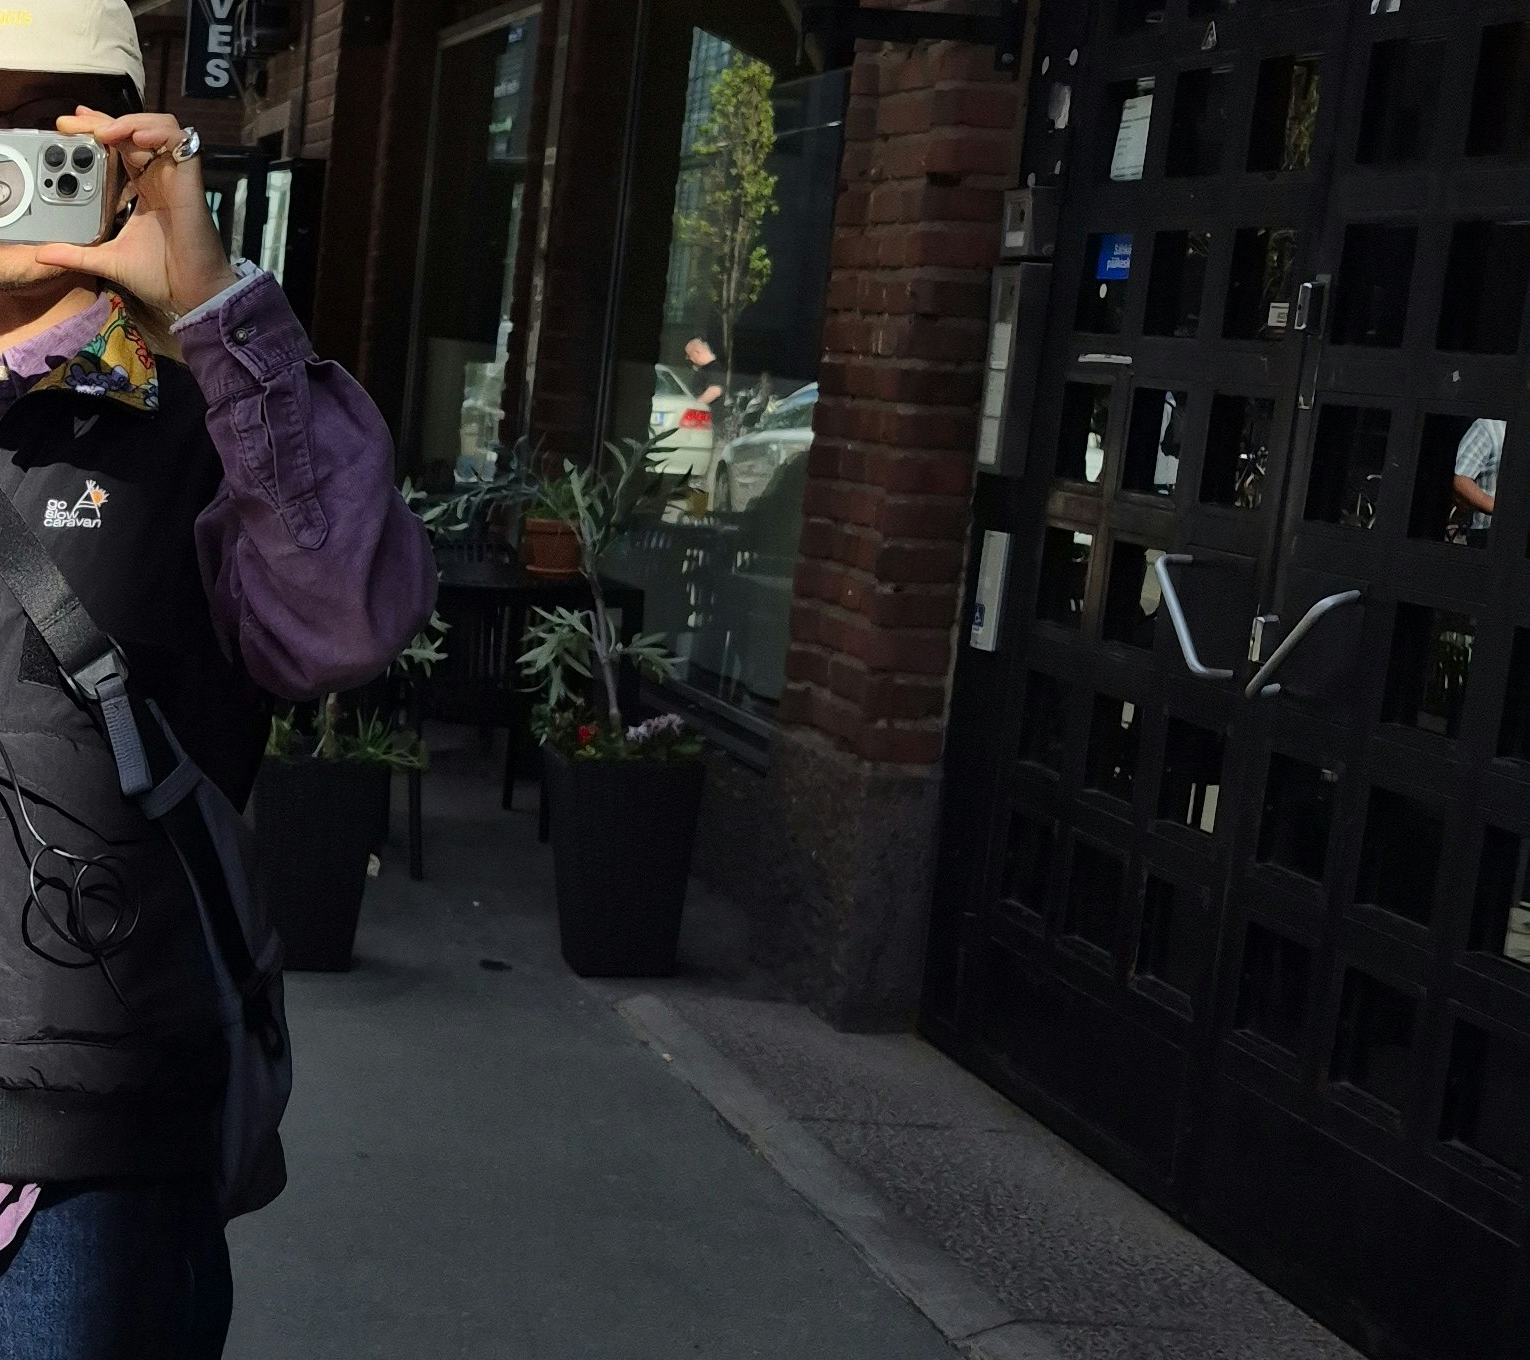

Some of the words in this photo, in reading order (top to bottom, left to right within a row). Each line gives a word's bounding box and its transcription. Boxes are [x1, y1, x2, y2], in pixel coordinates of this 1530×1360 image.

[46, 499, 68, 511] go
[44, 509, 80, 520] slow
[43, 518, 102, 529] caravan
